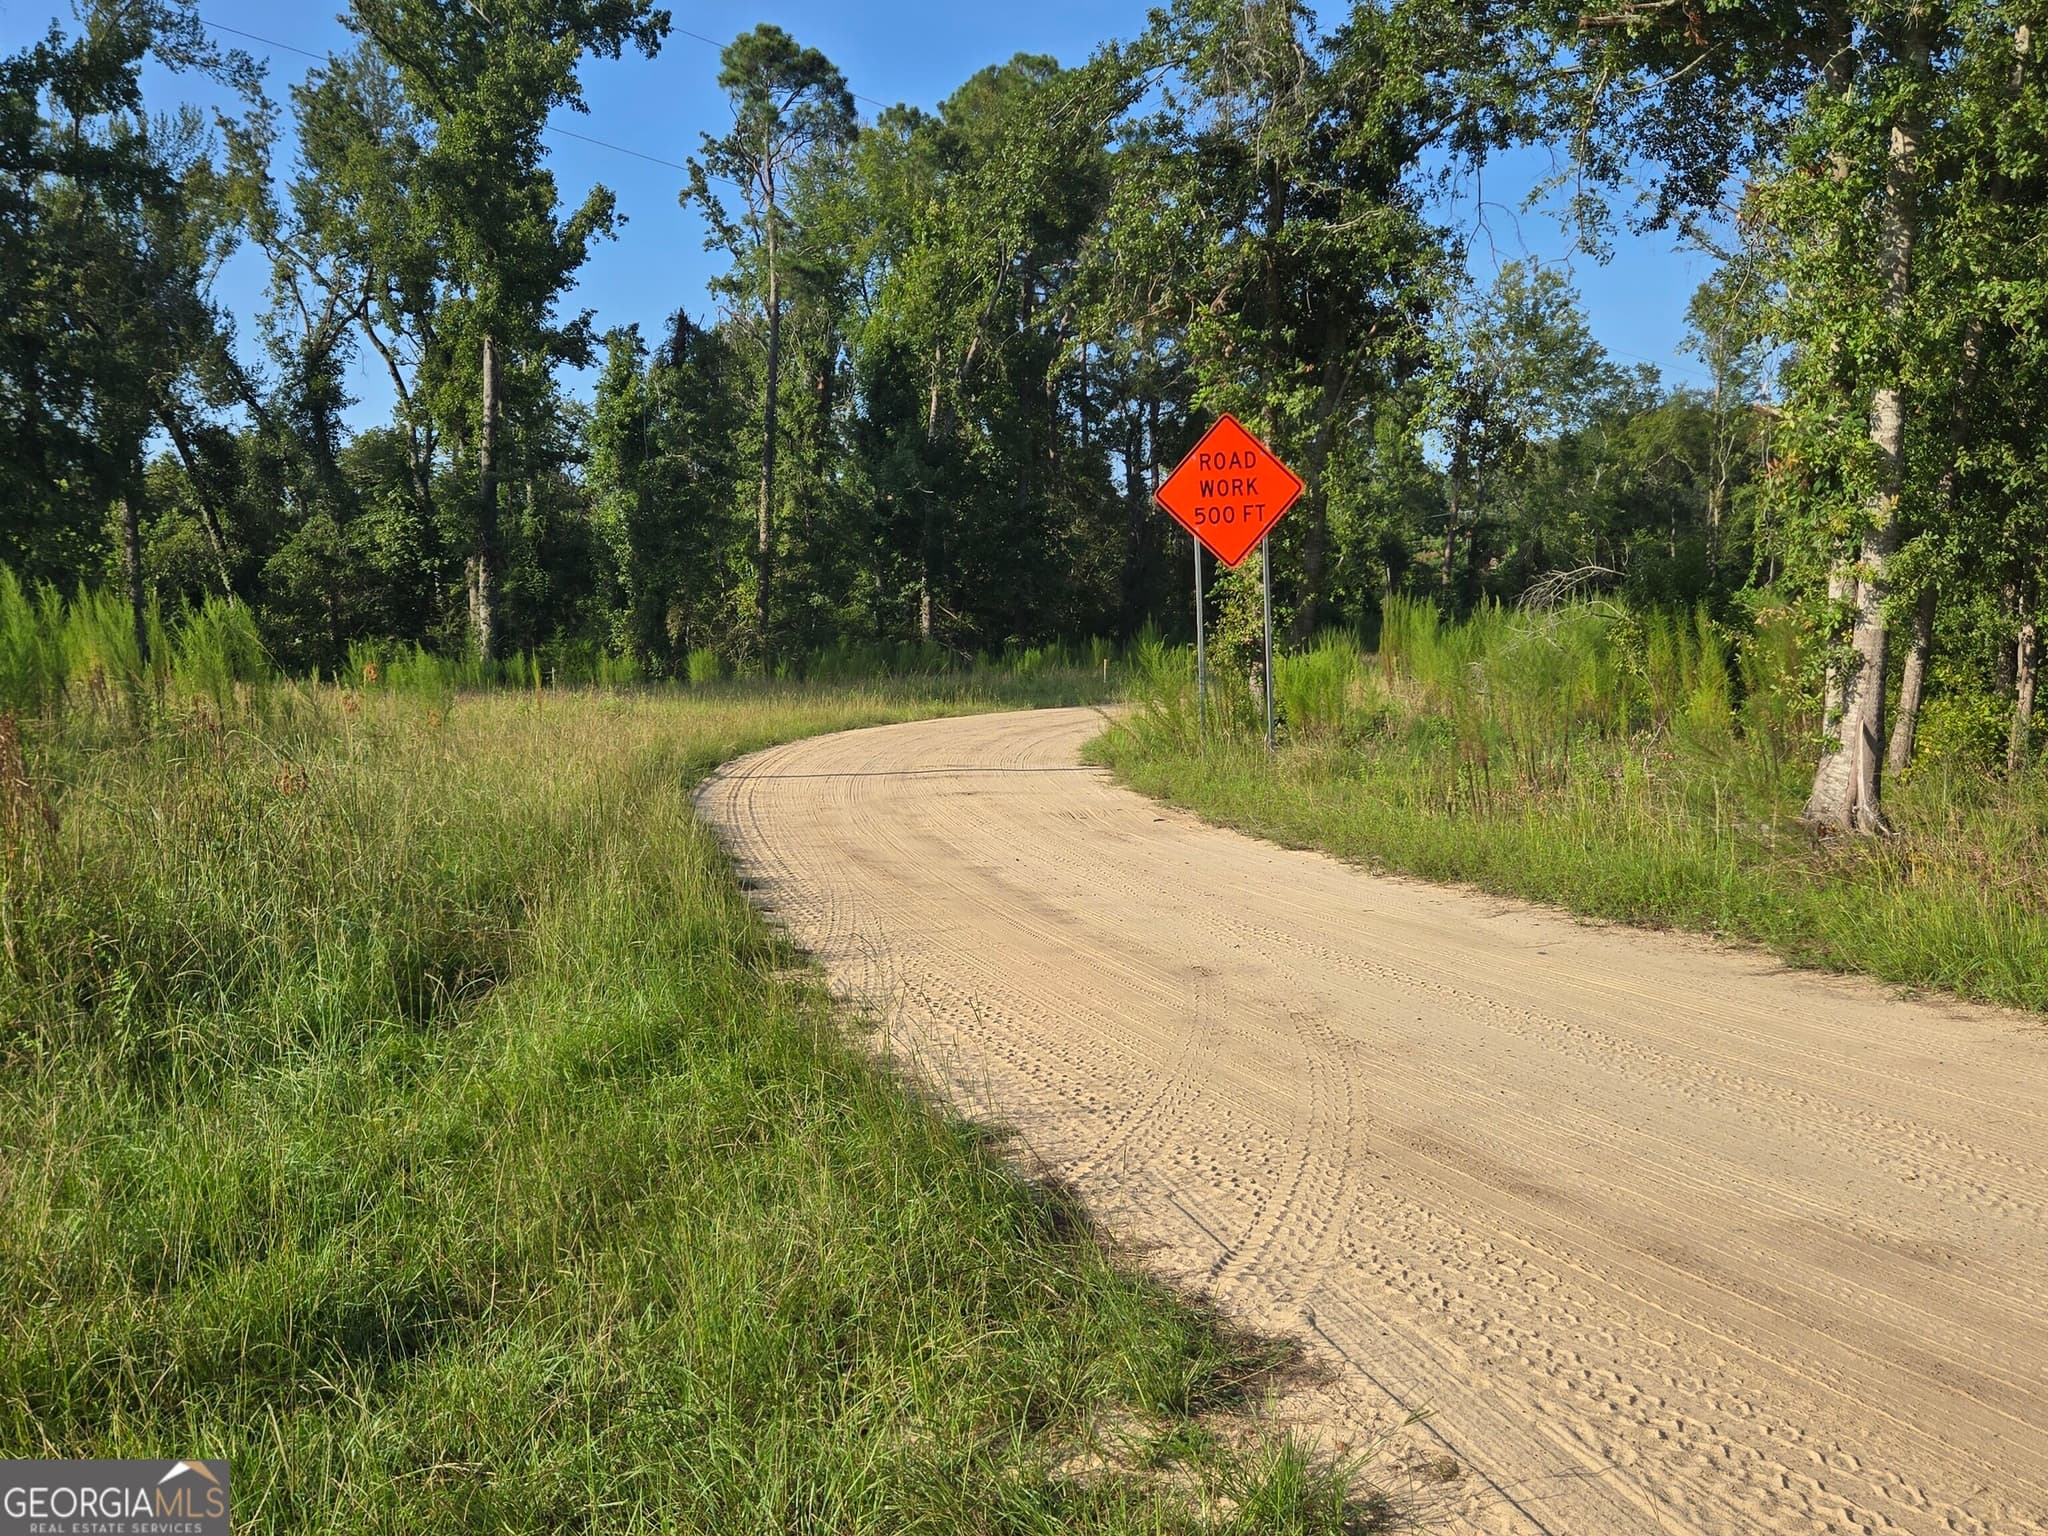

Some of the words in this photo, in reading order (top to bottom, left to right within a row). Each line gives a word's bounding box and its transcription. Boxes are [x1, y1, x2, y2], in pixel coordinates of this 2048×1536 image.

[1200, 451, 1256, 471] ROAD
[1200, 477, 1258, 497] WORK
[1194, 506, 1235, 525] 500
[1243, 504, 1265, 522] FT
